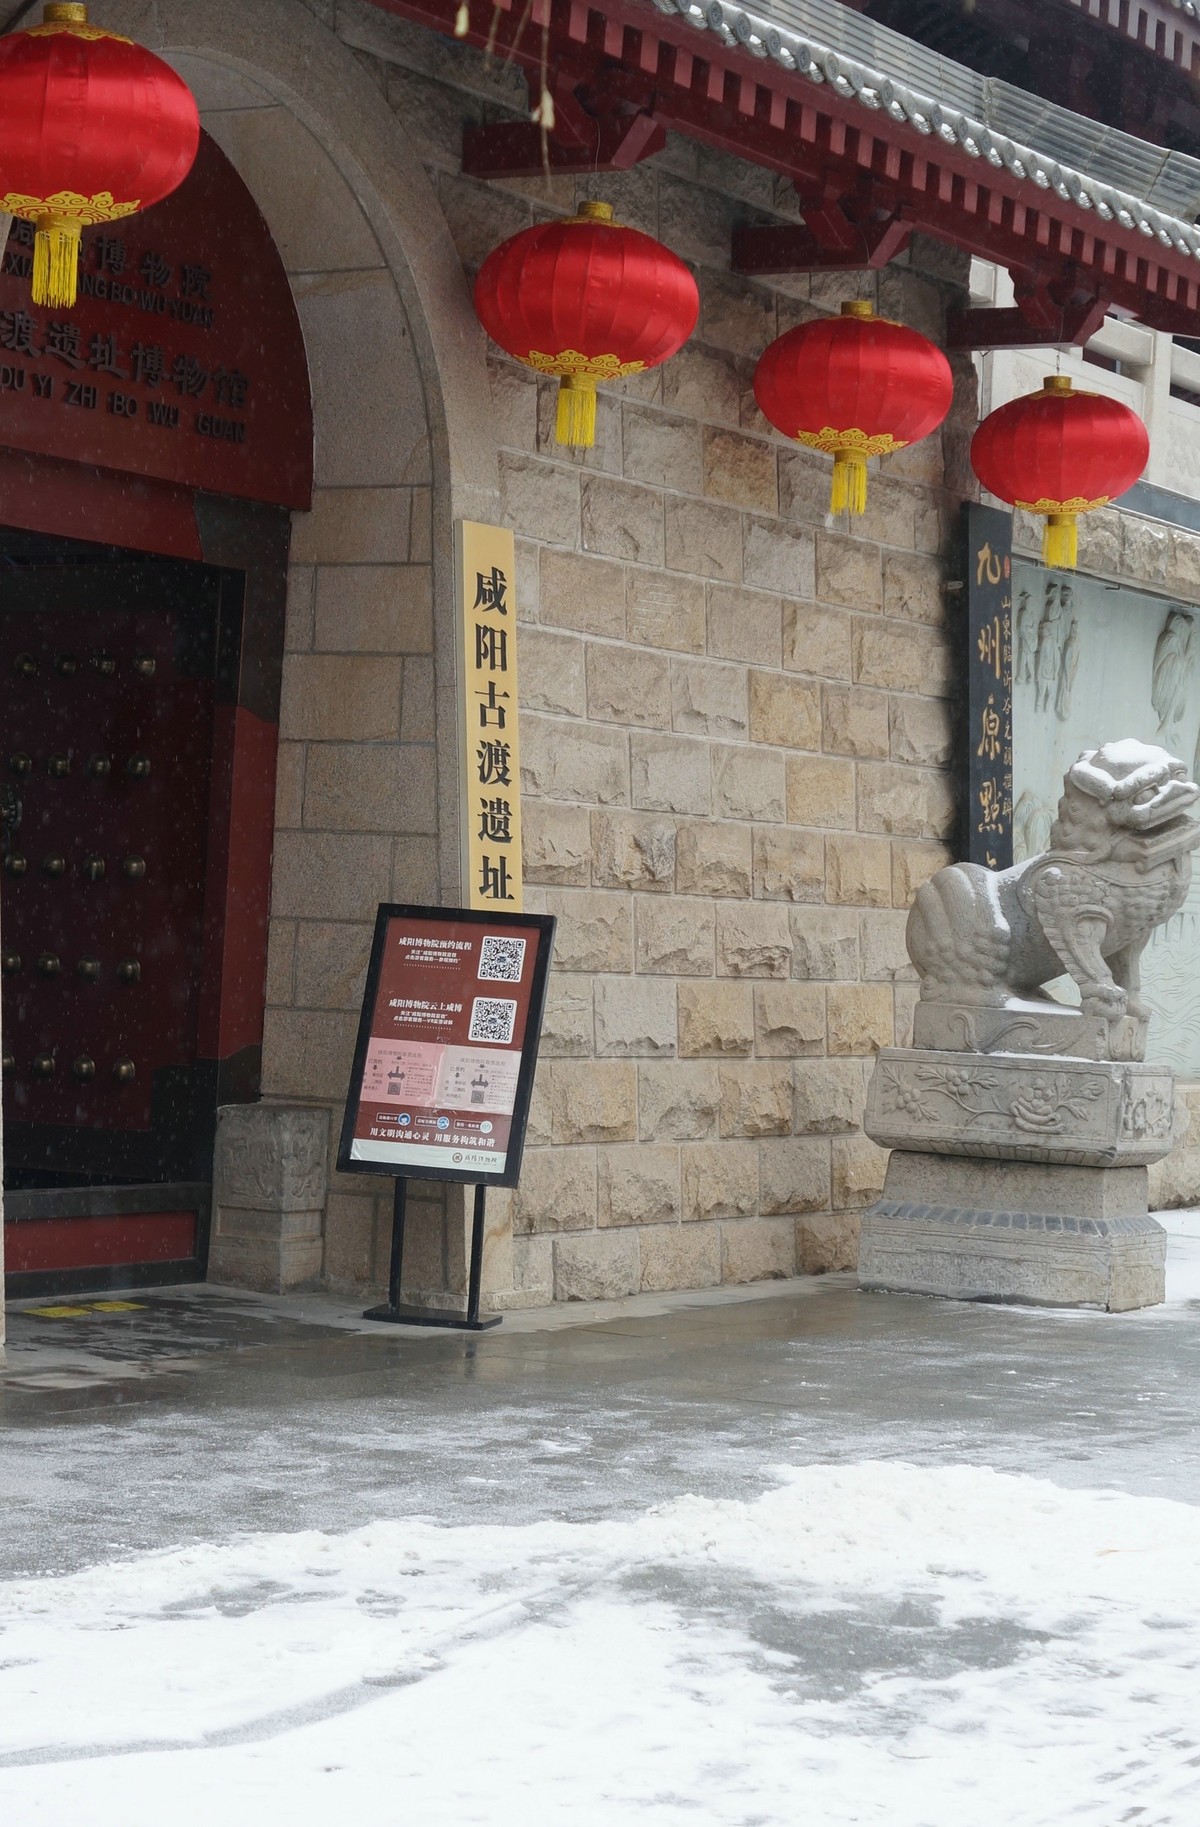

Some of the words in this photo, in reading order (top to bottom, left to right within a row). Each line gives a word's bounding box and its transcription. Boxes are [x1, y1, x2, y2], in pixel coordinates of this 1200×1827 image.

[138, 289, 168, 314] WU
[170, 298, 214, 329] YUAN
[34, 373, 54, 398] YI
[67, 381, 99, 409] ZHI
[112, 391, 138, 417] BO
[152, 402, 181, 428] WU
[198, 412, 247, 443] GUAN
[473, 566, 515, 902] 咸阳古渡遗址
[398, 936, 472, 951] 咸阳博物院预约流程
[388, 998, 463, 1013] 咸阳博物院云上咸博
[370, 1127, 430, 1141] 用文明沟通心灵
[434, 1132, 496, 1147] 用服务构筑和谐
